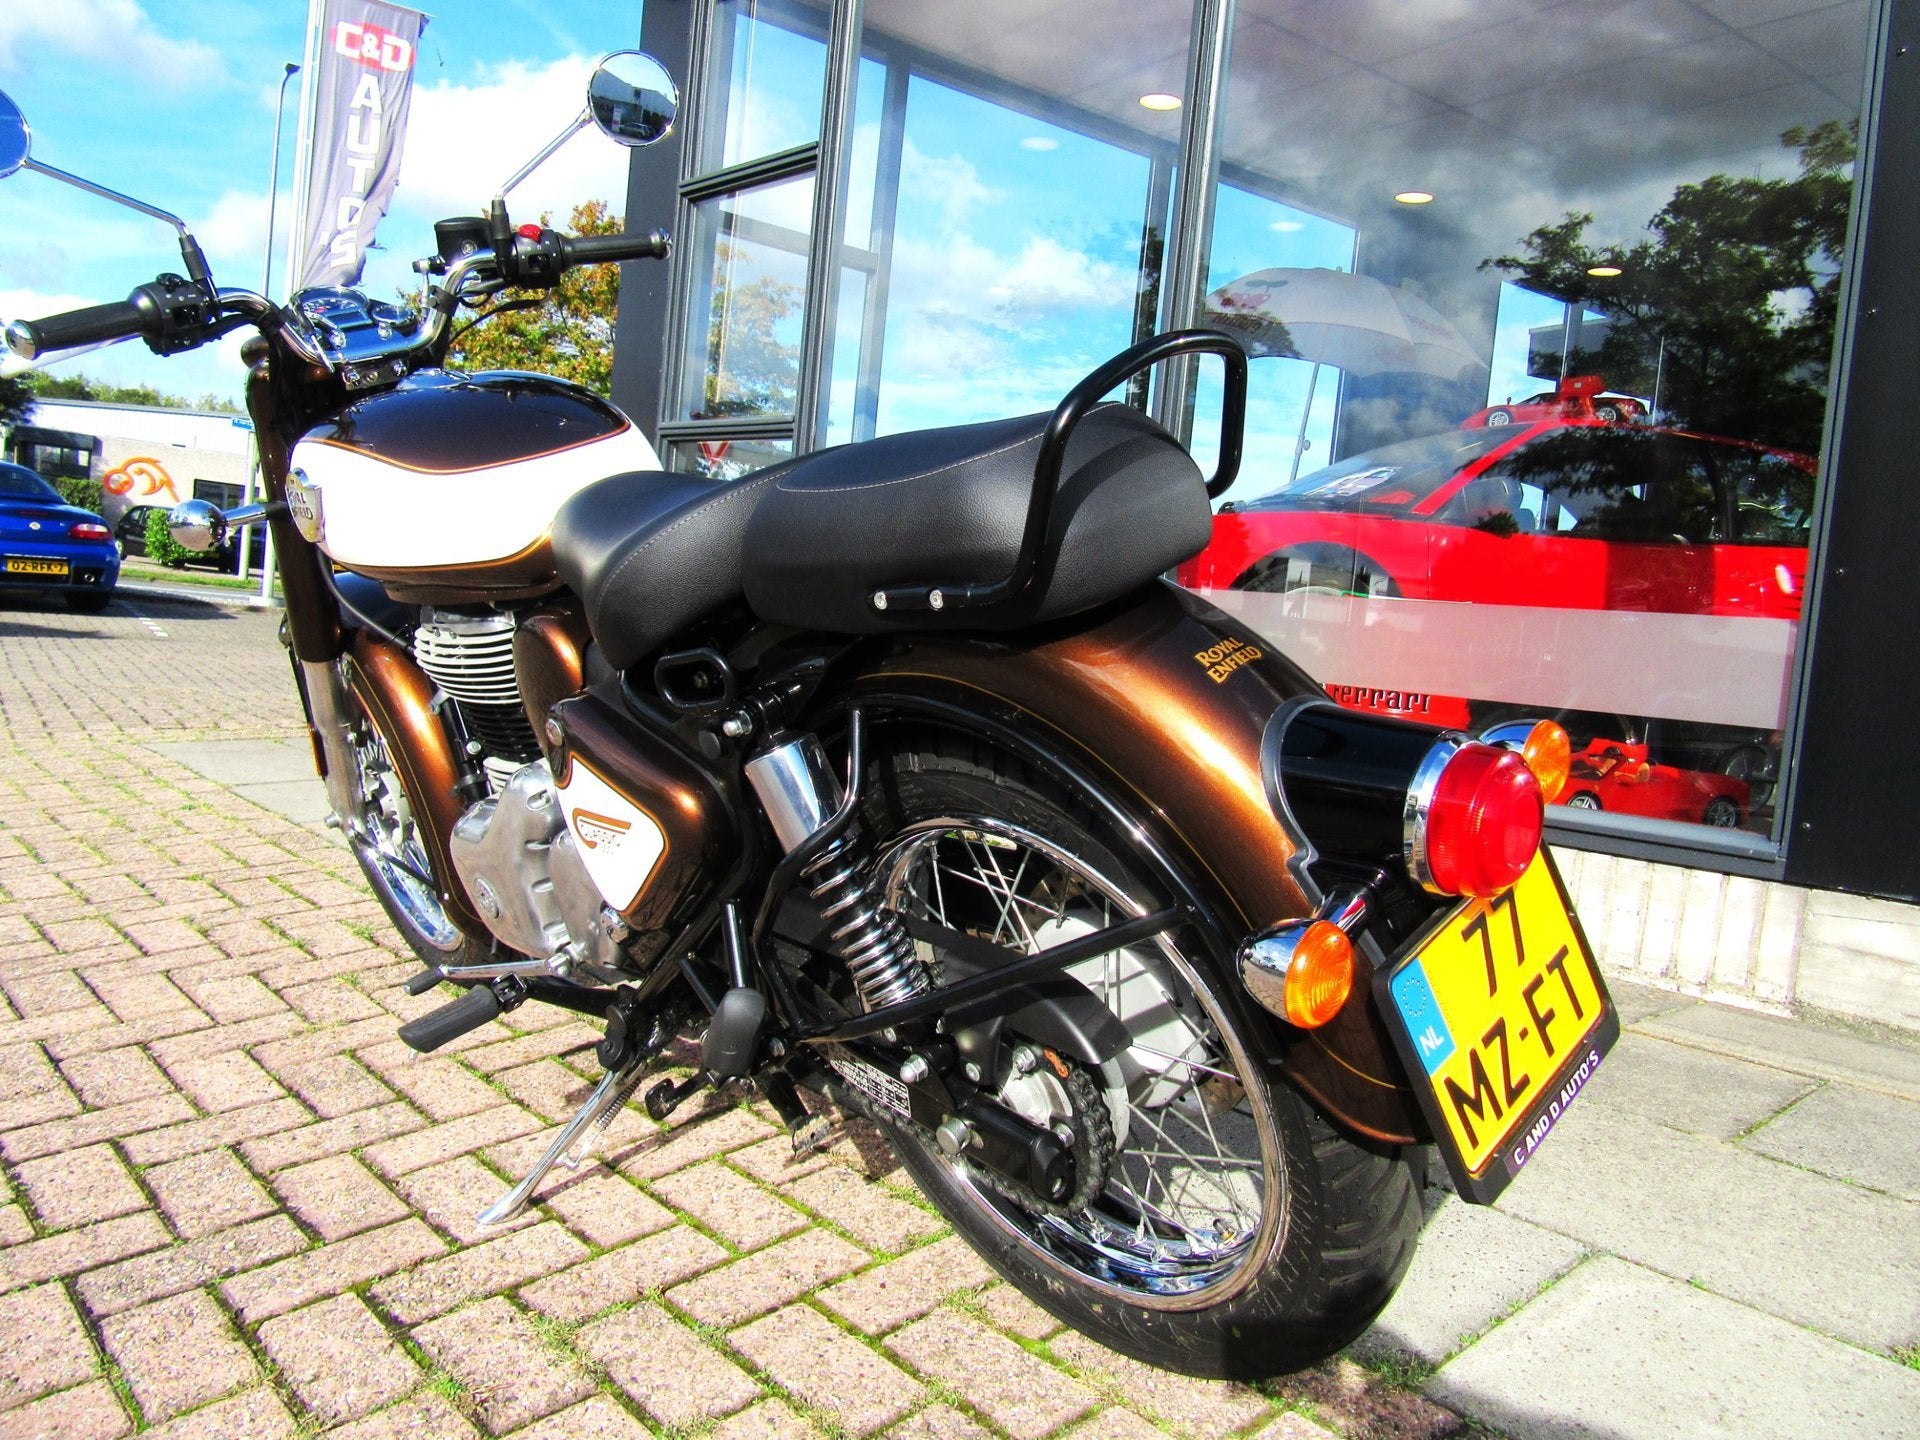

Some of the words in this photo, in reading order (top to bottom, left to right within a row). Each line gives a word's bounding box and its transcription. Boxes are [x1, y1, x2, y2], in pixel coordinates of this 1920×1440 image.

[335, 21, 413, 72] C&D
[12, 561, 64, 573] 02-RFK-7
[1194, 637, 1244, 668] ROYAL
[1206, 646, 1262, 684] ENFIELD
[1461, 885, 1526, 998] 77
[1418, 1025, 1444, 1057] NL
[1443, 944, 1584, 1150] MZ-FT
[1512, 1146, 1526, 1166] C
[1525, 1114, 1550, 1154] AND
[1549, 1101, 1560, 1119] D
[1560, 1049, 1600, 1108] AUTO'S
